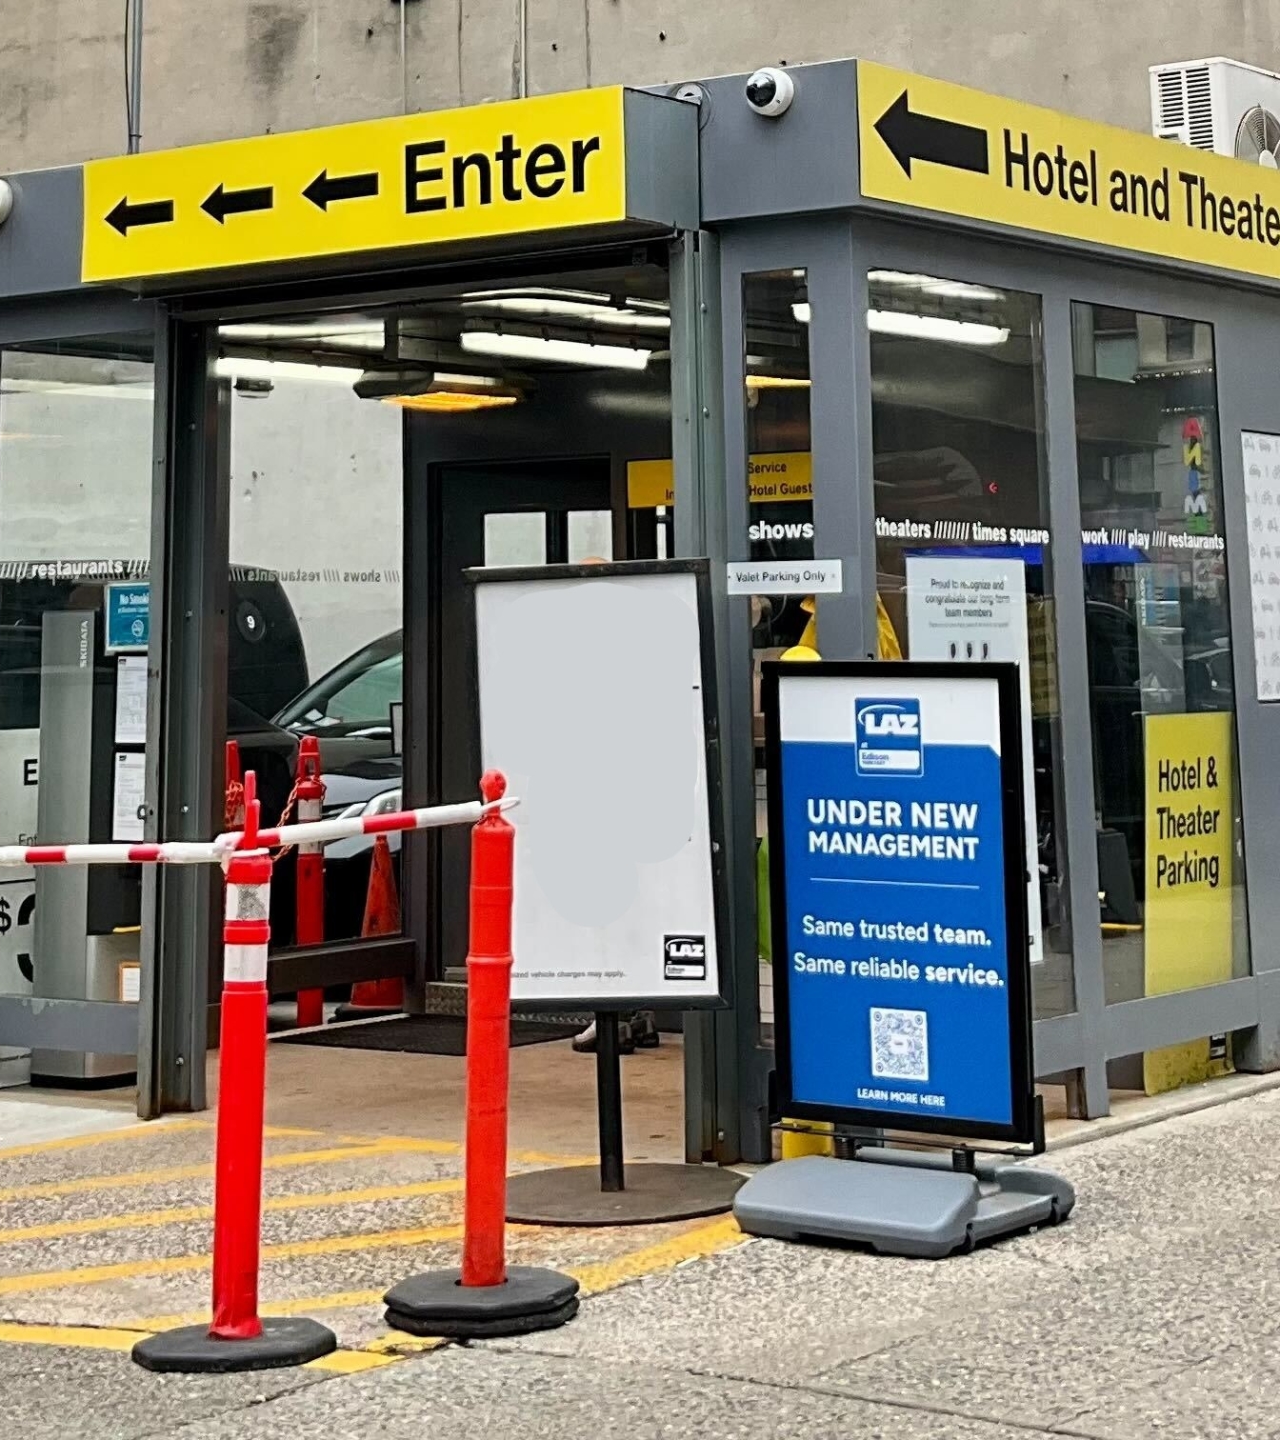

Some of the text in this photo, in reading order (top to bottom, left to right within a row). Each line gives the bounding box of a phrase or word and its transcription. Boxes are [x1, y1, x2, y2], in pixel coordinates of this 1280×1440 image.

[404, 134, 600, 215] Enter
[1003, 127, 1098, 207] Hotel
[1109, 166, 1171, 222] and
[748, 462, 788, 474] Service
[749, 484, 777, 496] Hotel
[780, 482, 813, 495] Guest
[749, 518, 1225, 550] shows theaters times square work play restaurants
[32, 560, 124, 578] restaurants
[735, 568, 826, 585] Valet Parking Only
[930, 578, 951, 589] Proud
[992, 580, 1005, 590] and
[129, 593, 149, 605] Smoki
[945, 608, 993, 618] team members
[865, 713, 920, 736] LAZ
[1158, 755, 1218, 793] Hotel &
[807, 798, 979, 831] UNDER NEW
[1156, 806, 1220, 840] Theater
[808, 832, 980, 861] MANAGEMENT
[1156, 850, 1220, 888] Parking
[803, 915, 992, 947] Same trusted team.
[669, 943, 705, 957] LAZ
[794, 952, 1005, 988] Same reliable service.
[857, 1087, 946, 1107] LEARN MORE HERE
